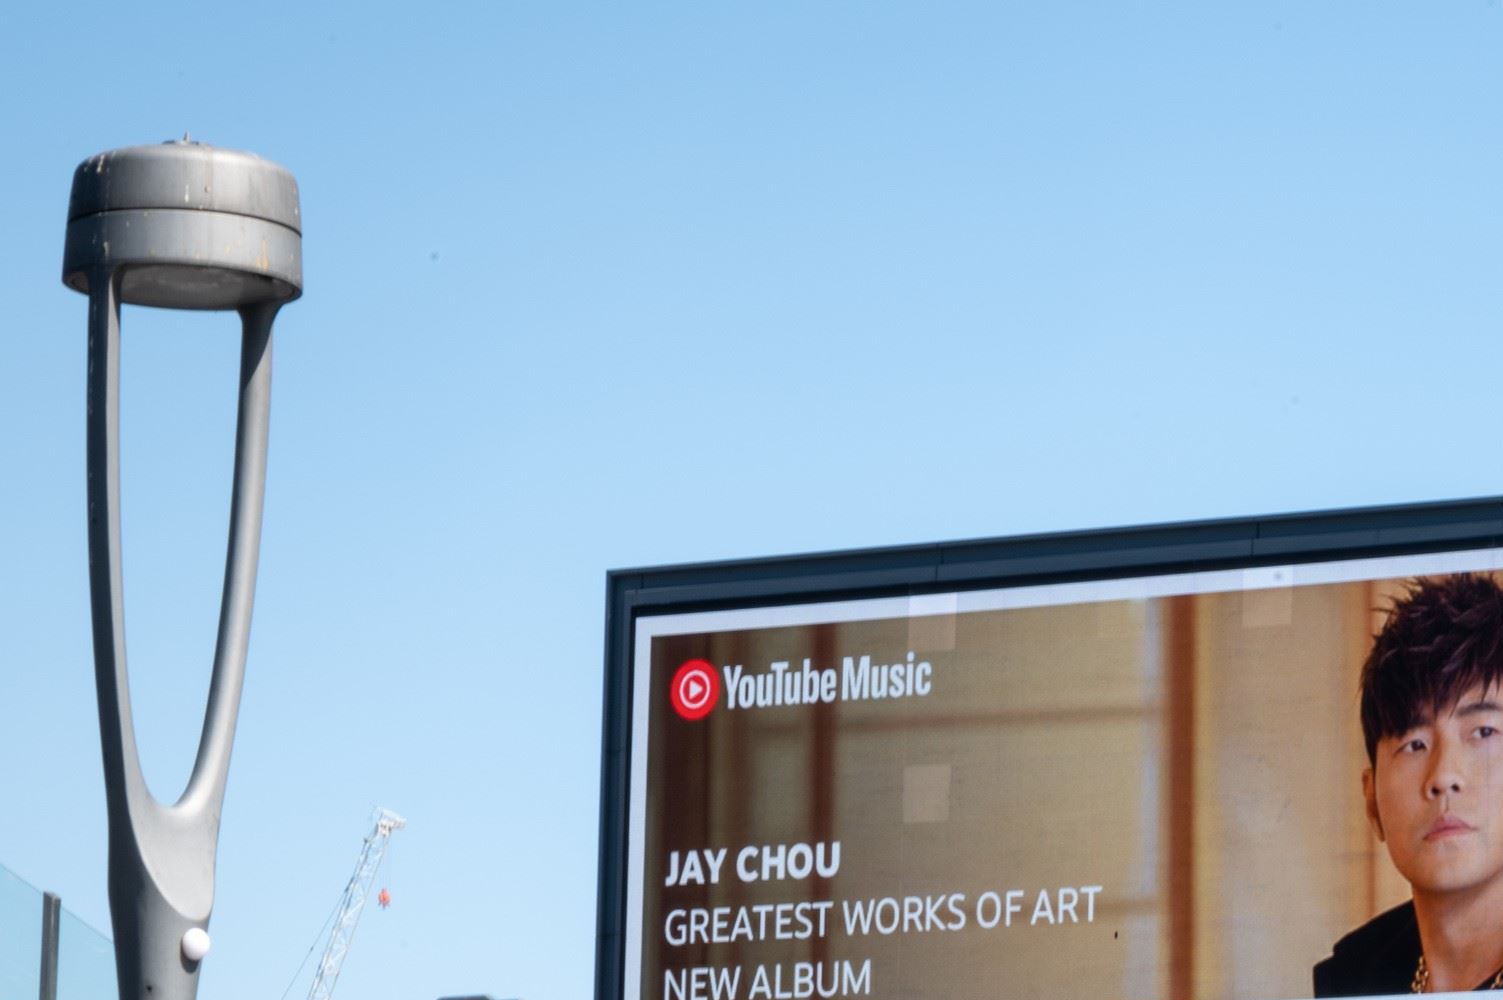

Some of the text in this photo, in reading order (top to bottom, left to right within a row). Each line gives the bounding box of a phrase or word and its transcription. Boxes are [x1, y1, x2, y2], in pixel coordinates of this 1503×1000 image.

[723, 651, 932, 710] YouTube Music
[664, 841, 841, 887] JAY CHOU
[664, 885, 1103, 946] GREATEST WORKS OF ART
[748, 959, 872, 1000] ALBUM
